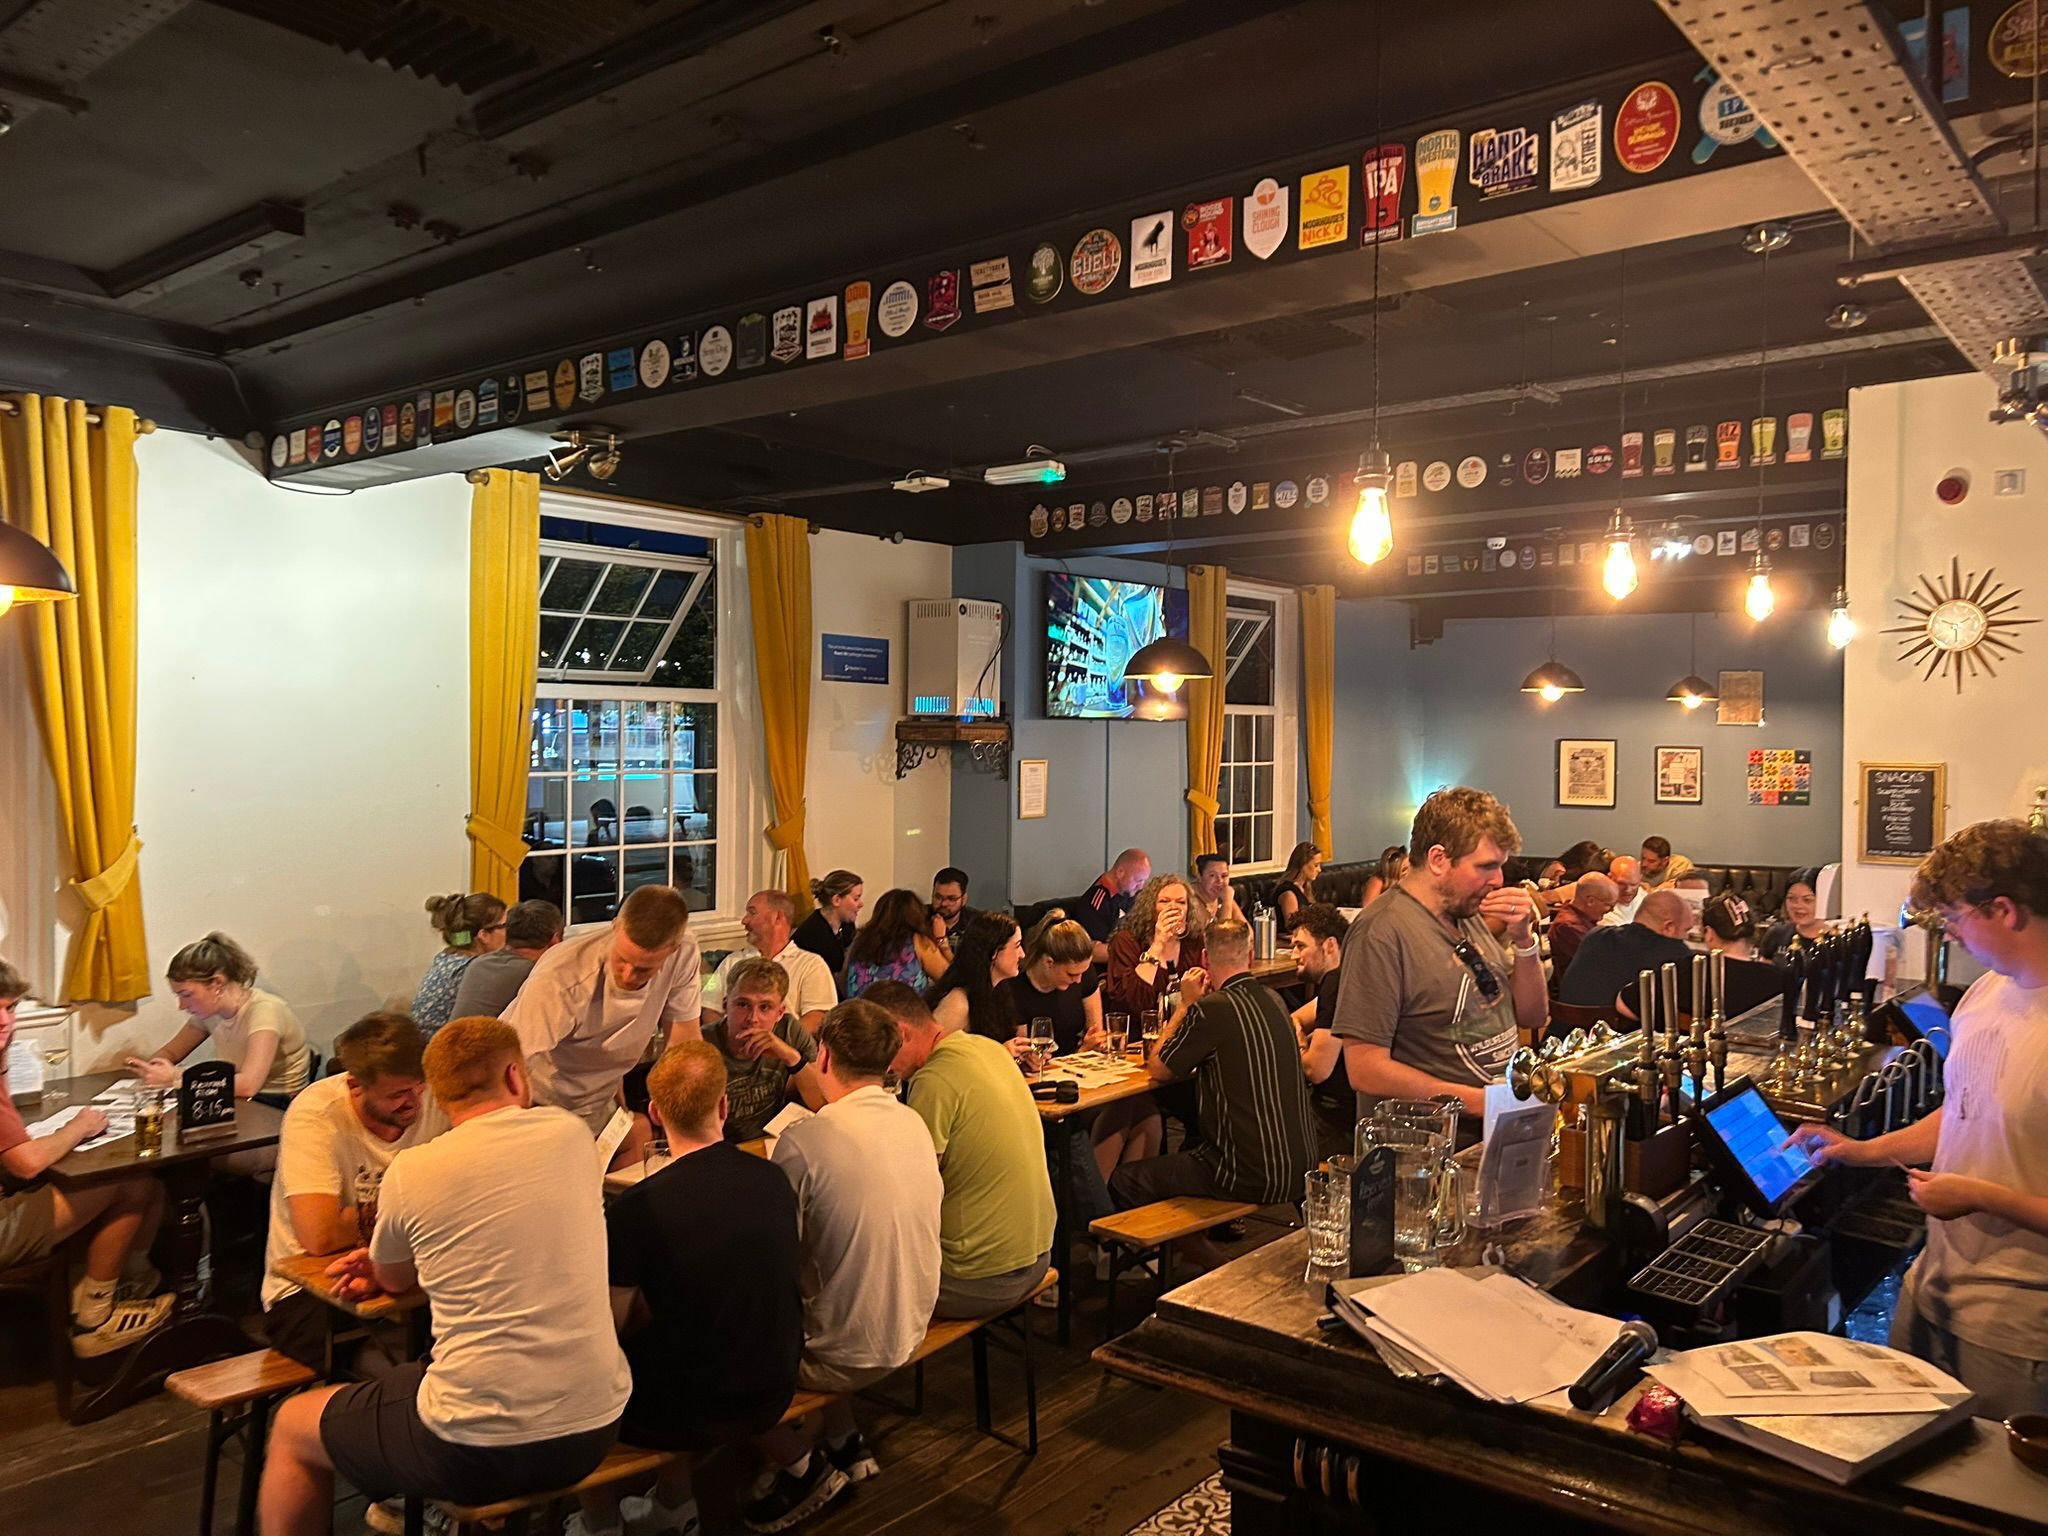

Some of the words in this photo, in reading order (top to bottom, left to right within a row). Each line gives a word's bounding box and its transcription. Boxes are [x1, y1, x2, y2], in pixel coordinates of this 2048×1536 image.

[1418, 134, 1457, 155] NORTH
[1473, 131, 1523, 170] HAND
[1481, 140, 1534, 185] BRAKE
[1366, 166, 1399, 200] IPA
[1302, 227, 1330, 244] NICK
[1874, 771, 1926, 784] SNACKS
